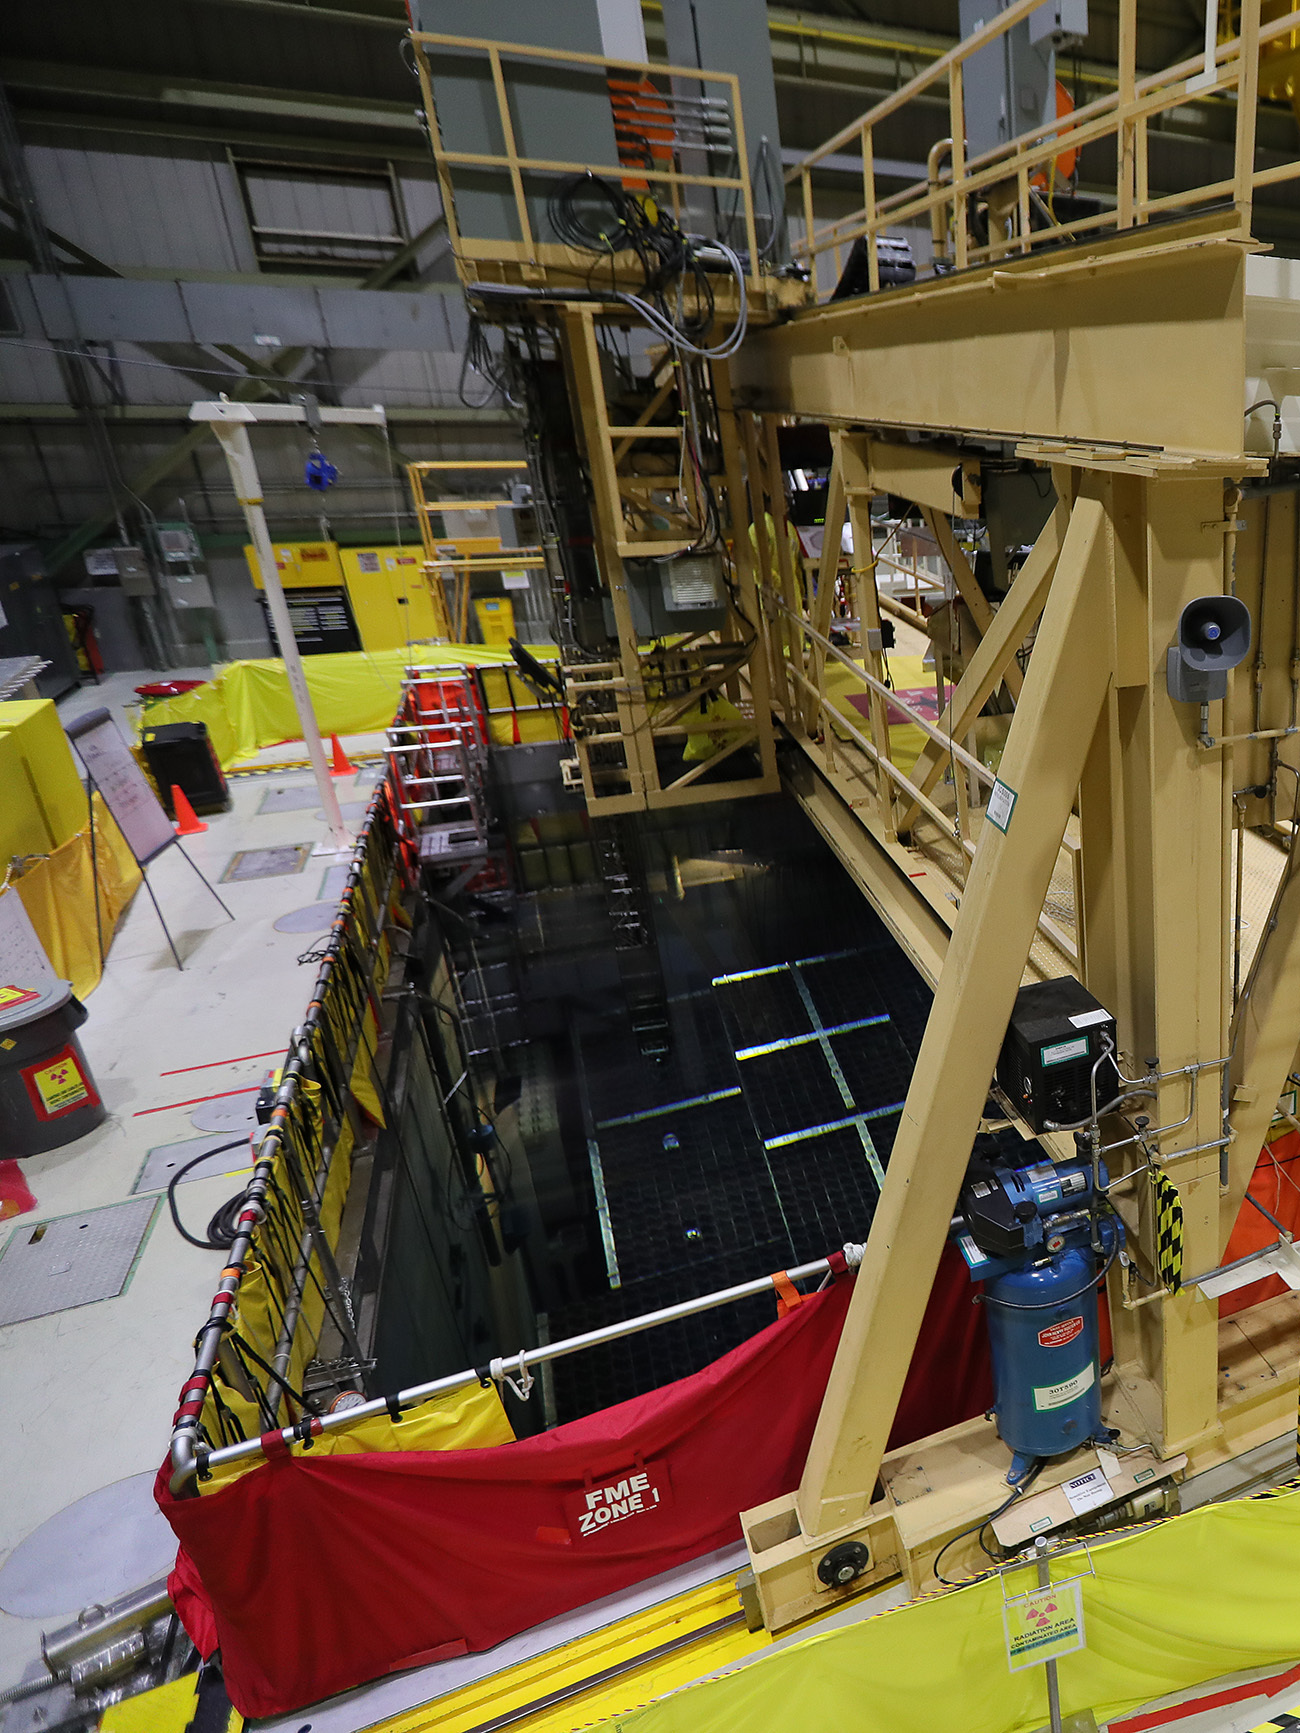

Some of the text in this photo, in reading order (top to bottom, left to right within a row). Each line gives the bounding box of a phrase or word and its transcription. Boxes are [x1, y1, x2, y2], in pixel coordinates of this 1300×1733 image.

[585, 1472, 651, 1511] FME
[1070, 1473, 1096, 1489] NOTICE
[578, 1493, 644, 1532] ZONE
[651, 1487, 660, 1503] 1
[1023, 1594, 1057, 1608] CAUTION
[1011, 1630, 1058, 1649] CONTAMINATED
[1060, 1624, 1077, 1632] AREA
[1014, 1625, 1053, 1642] RADIATION
[1054, 1618, 1075, 1628] AREA
